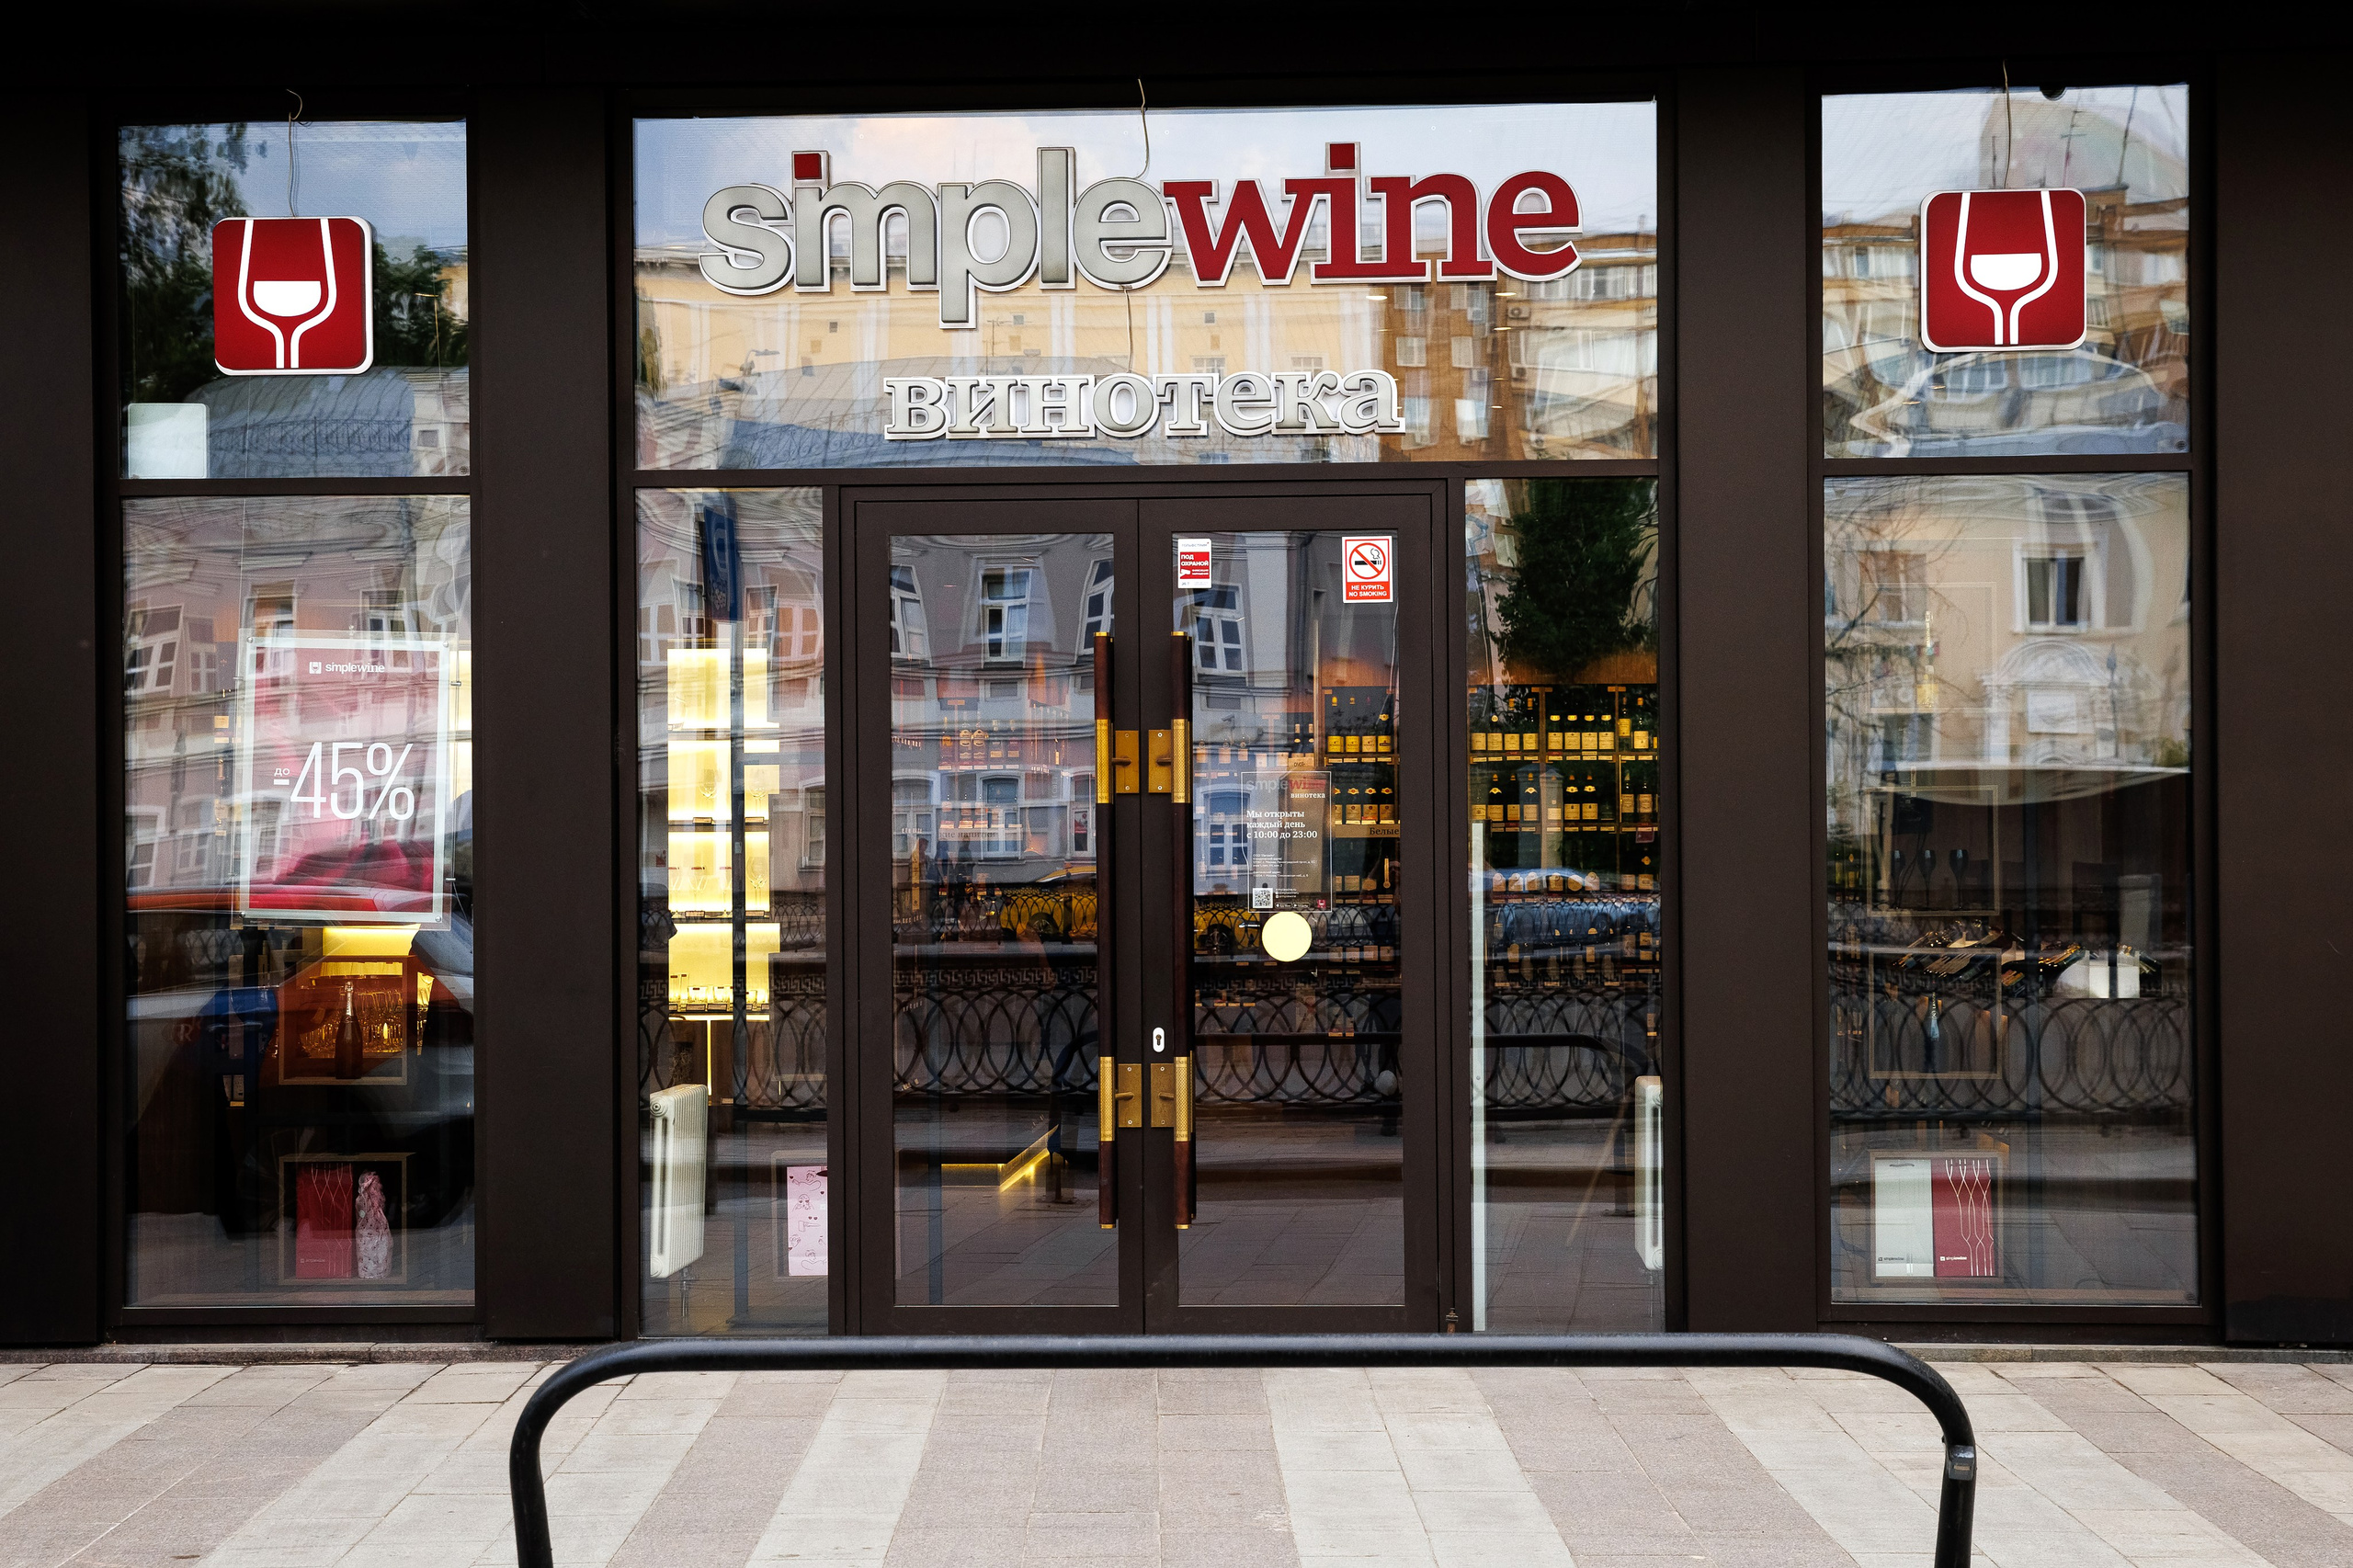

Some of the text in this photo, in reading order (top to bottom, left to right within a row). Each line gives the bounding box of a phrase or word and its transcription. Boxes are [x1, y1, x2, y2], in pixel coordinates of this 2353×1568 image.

[699, 142, 1582, 329] simplewine
[884, 369, 1405, 439] винотека
[325, 662, 385, 675] simplewine
[274, 767, 290, 777] до
[1264, 811, 1304, 819] открыты
[1246, 820, 1282, 829] каждый
